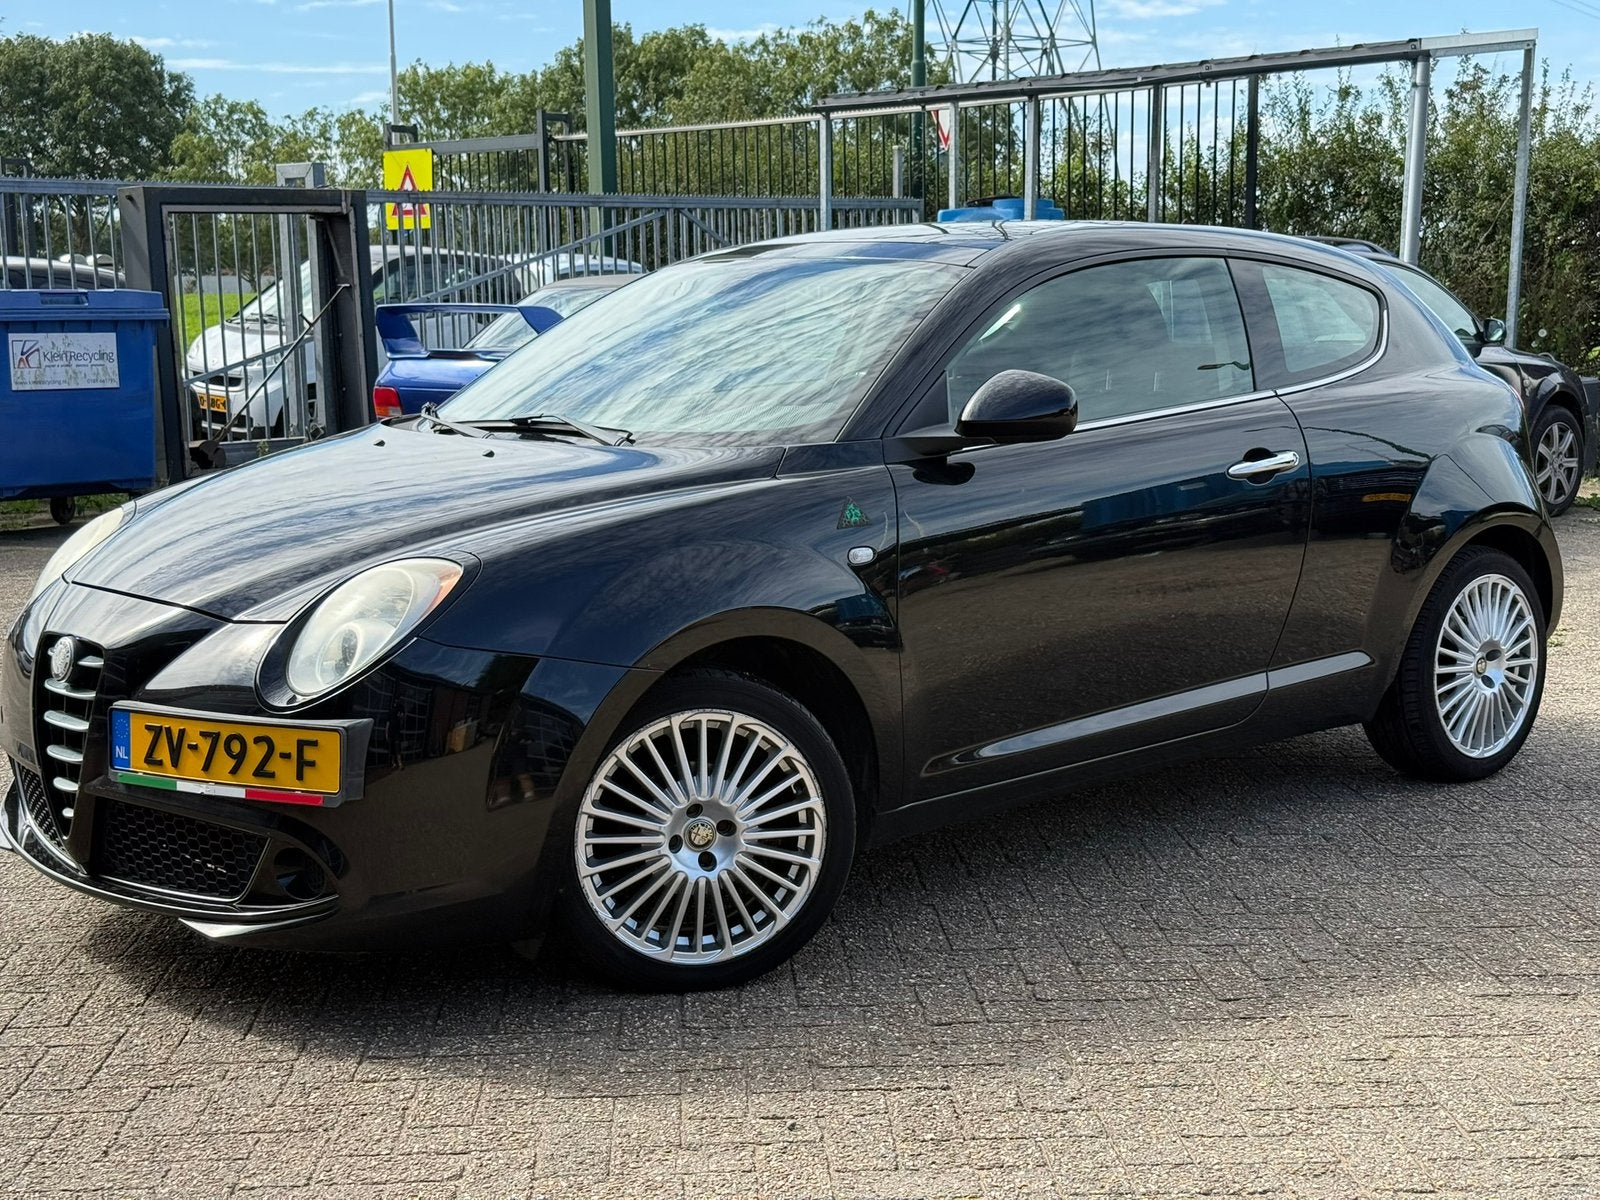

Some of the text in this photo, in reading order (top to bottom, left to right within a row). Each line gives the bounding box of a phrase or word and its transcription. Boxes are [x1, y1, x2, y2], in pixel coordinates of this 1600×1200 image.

[43, 349, 115, 364] Klein Recycling
[115, 745, 128, 759] NL
[144, 723, 318, 780] ZV-792-F
